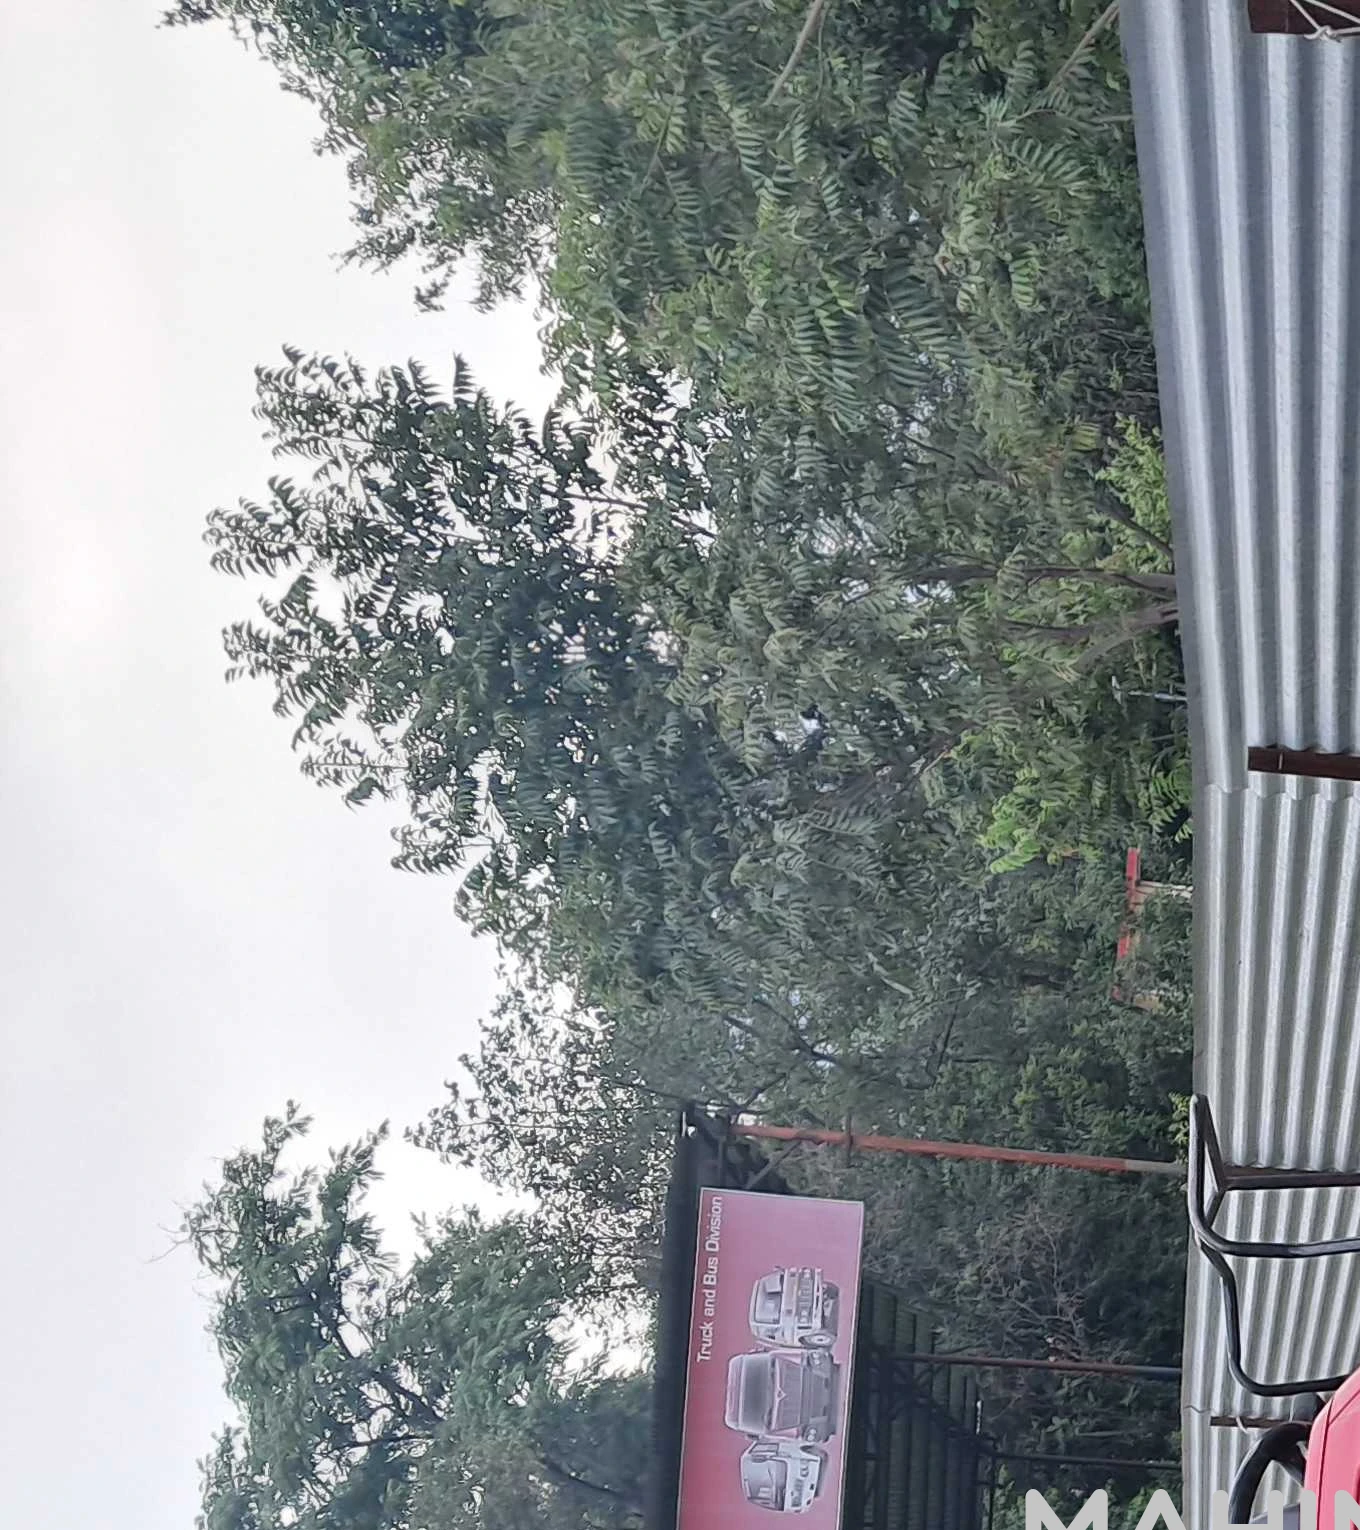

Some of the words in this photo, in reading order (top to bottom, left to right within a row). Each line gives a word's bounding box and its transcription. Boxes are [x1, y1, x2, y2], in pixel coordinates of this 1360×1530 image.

[705, 1196, 723, 1252] Division
[703, 1257, 719, 1285] Bus
[702, 1289, 717, 1316] and
[697, 1321, 714, 1362] Truck
